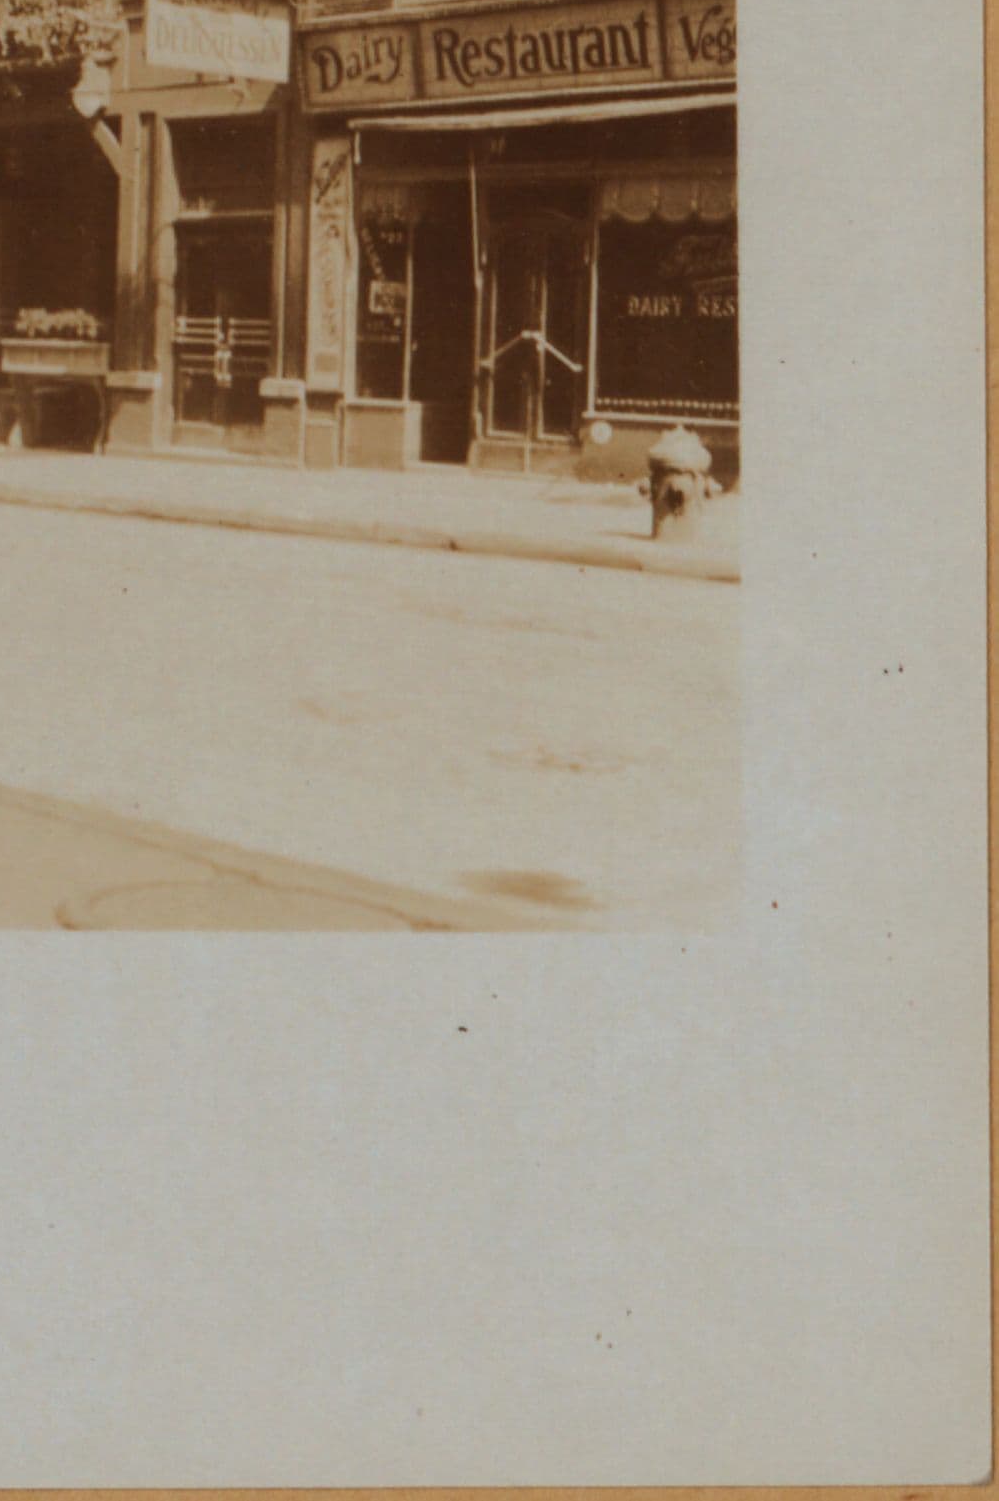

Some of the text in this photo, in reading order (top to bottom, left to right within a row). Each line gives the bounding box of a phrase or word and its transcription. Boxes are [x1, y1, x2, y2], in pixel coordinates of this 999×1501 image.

[312, 4, 737, 92] Dairy Restaurant Veg
[627, 294, 683, 317] DAIRY
